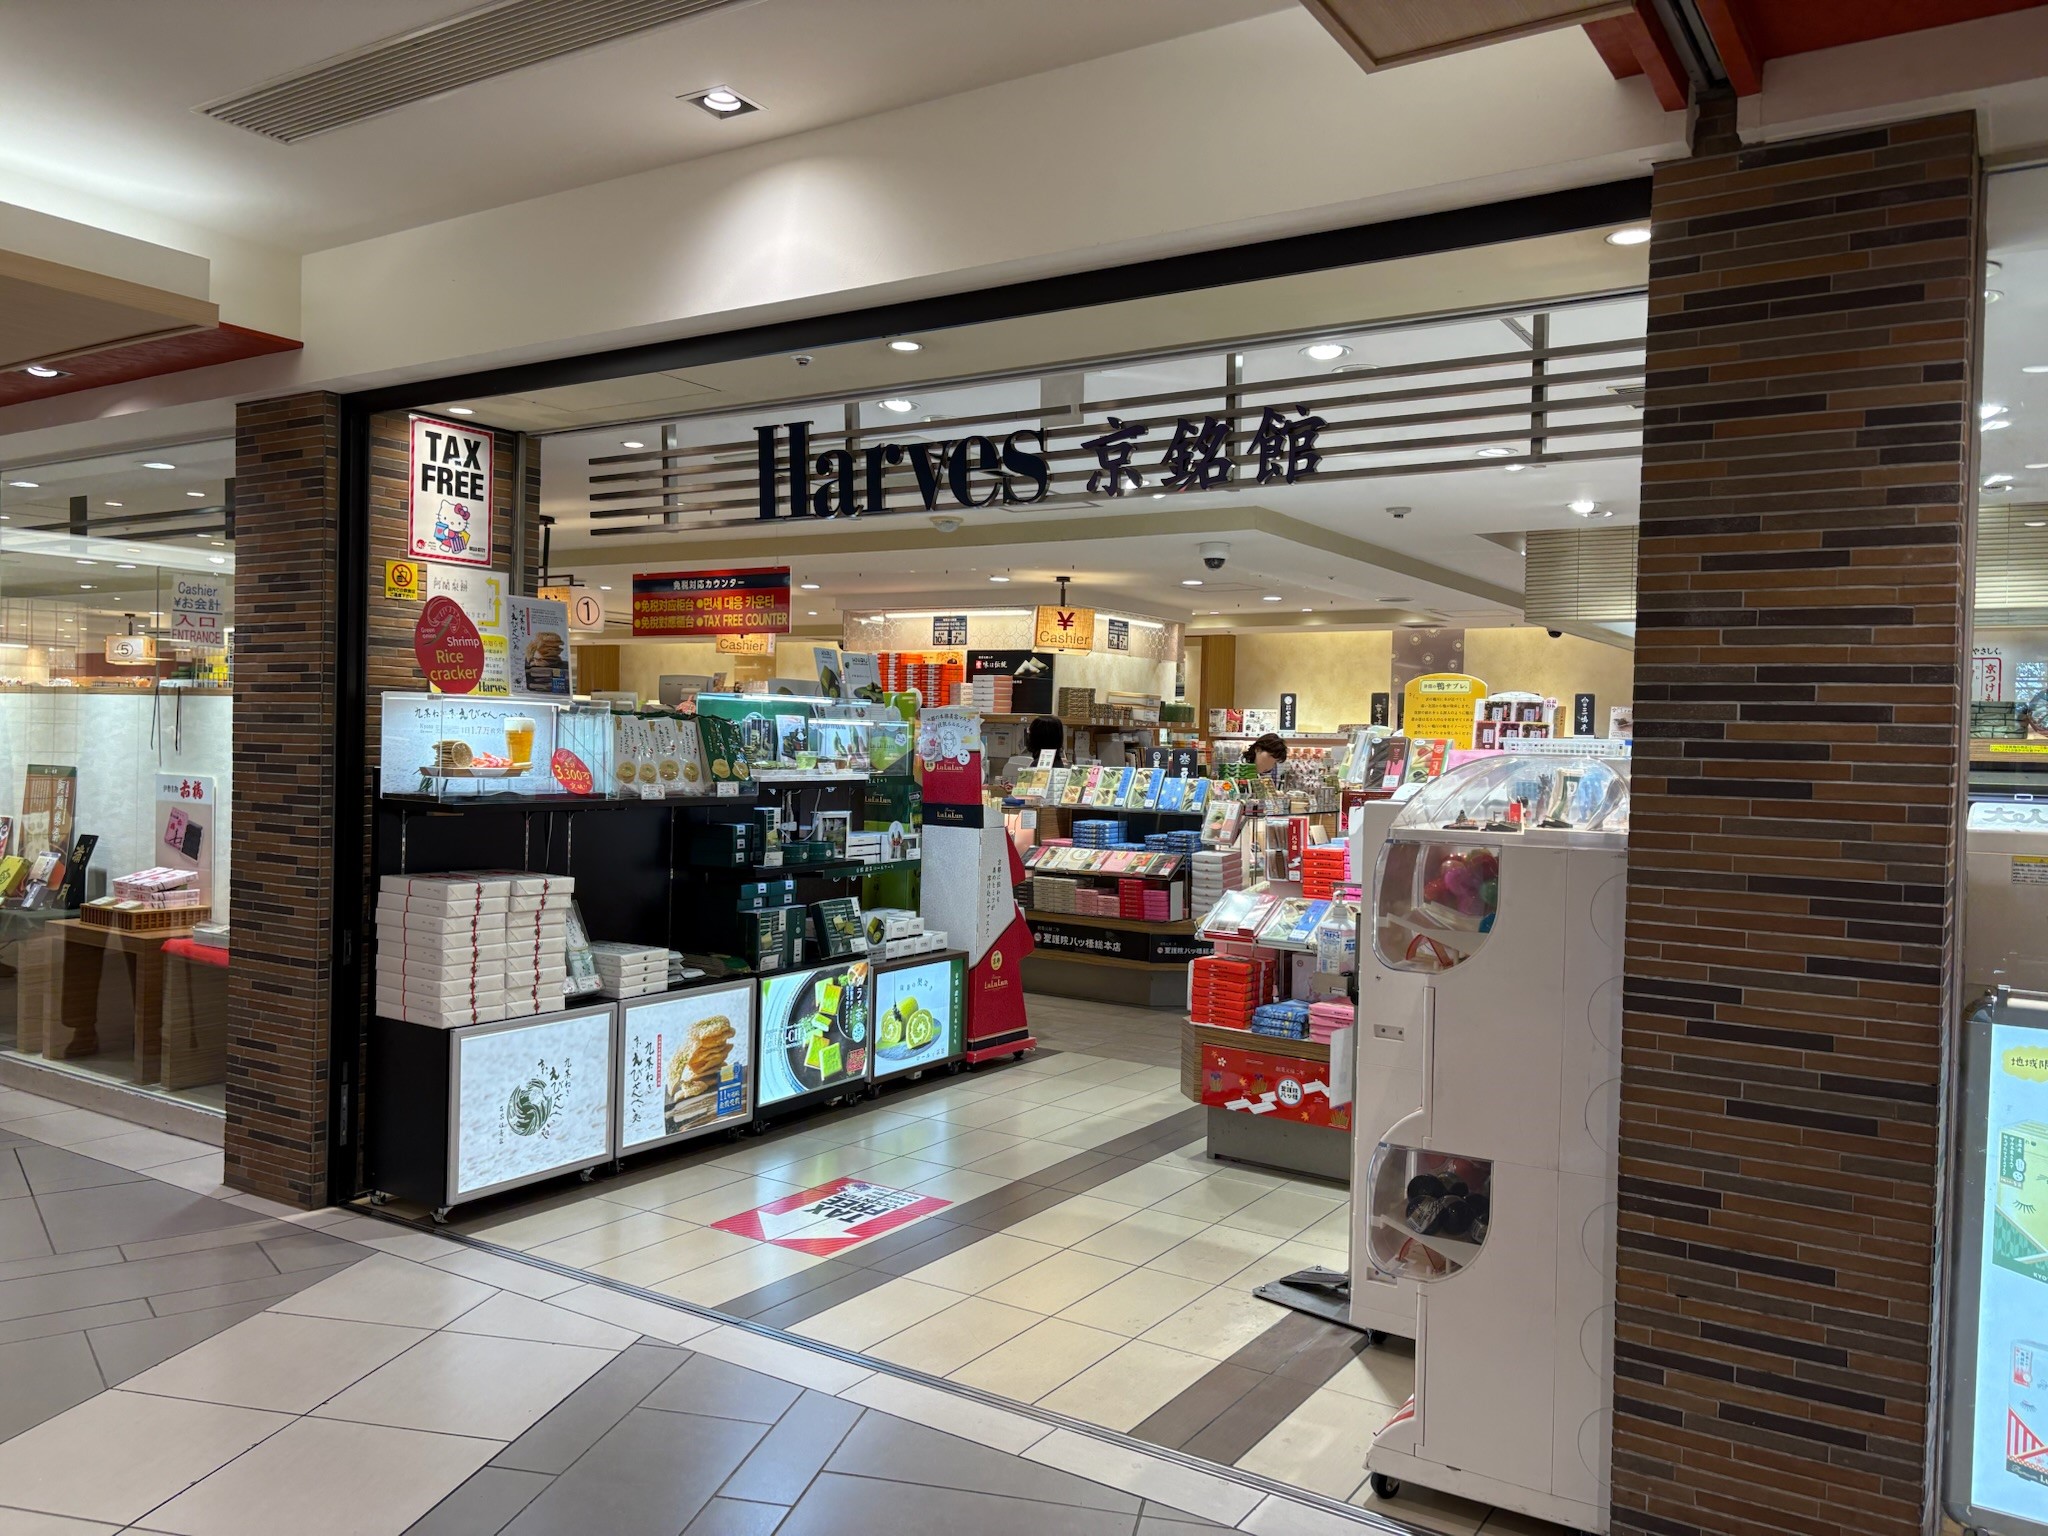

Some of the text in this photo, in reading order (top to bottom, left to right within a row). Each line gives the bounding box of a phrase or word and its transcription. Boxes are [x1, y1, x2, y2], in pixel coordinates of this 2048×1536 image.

[425, 430, 481, 471] TAX
[1080, 405, 1328, 497] 京銘館
[753, 420, 1051, 520] Harves
[421, 463, 484, 501] FREE
[178, 581, 218, 597] Cashier
[175, 614, 216, 628] 入口
[703, 612, 787, 627] TAX FREE COUNTER
[172, 629, 221, 644] ENTRANCE
[446, 637, 480, 648] Shrimp
[719, 638, 764, 651] Cashier
[1040, 630, 1089, 645] Cashier
[435, 650, 464, 663] Rice
[430, 665, 478, 681] cracker
[180, 779, 203, 799] 赤福
[804, 1203, 863, 1224] TAX
[820, 1195, 890, 1217] FREE
